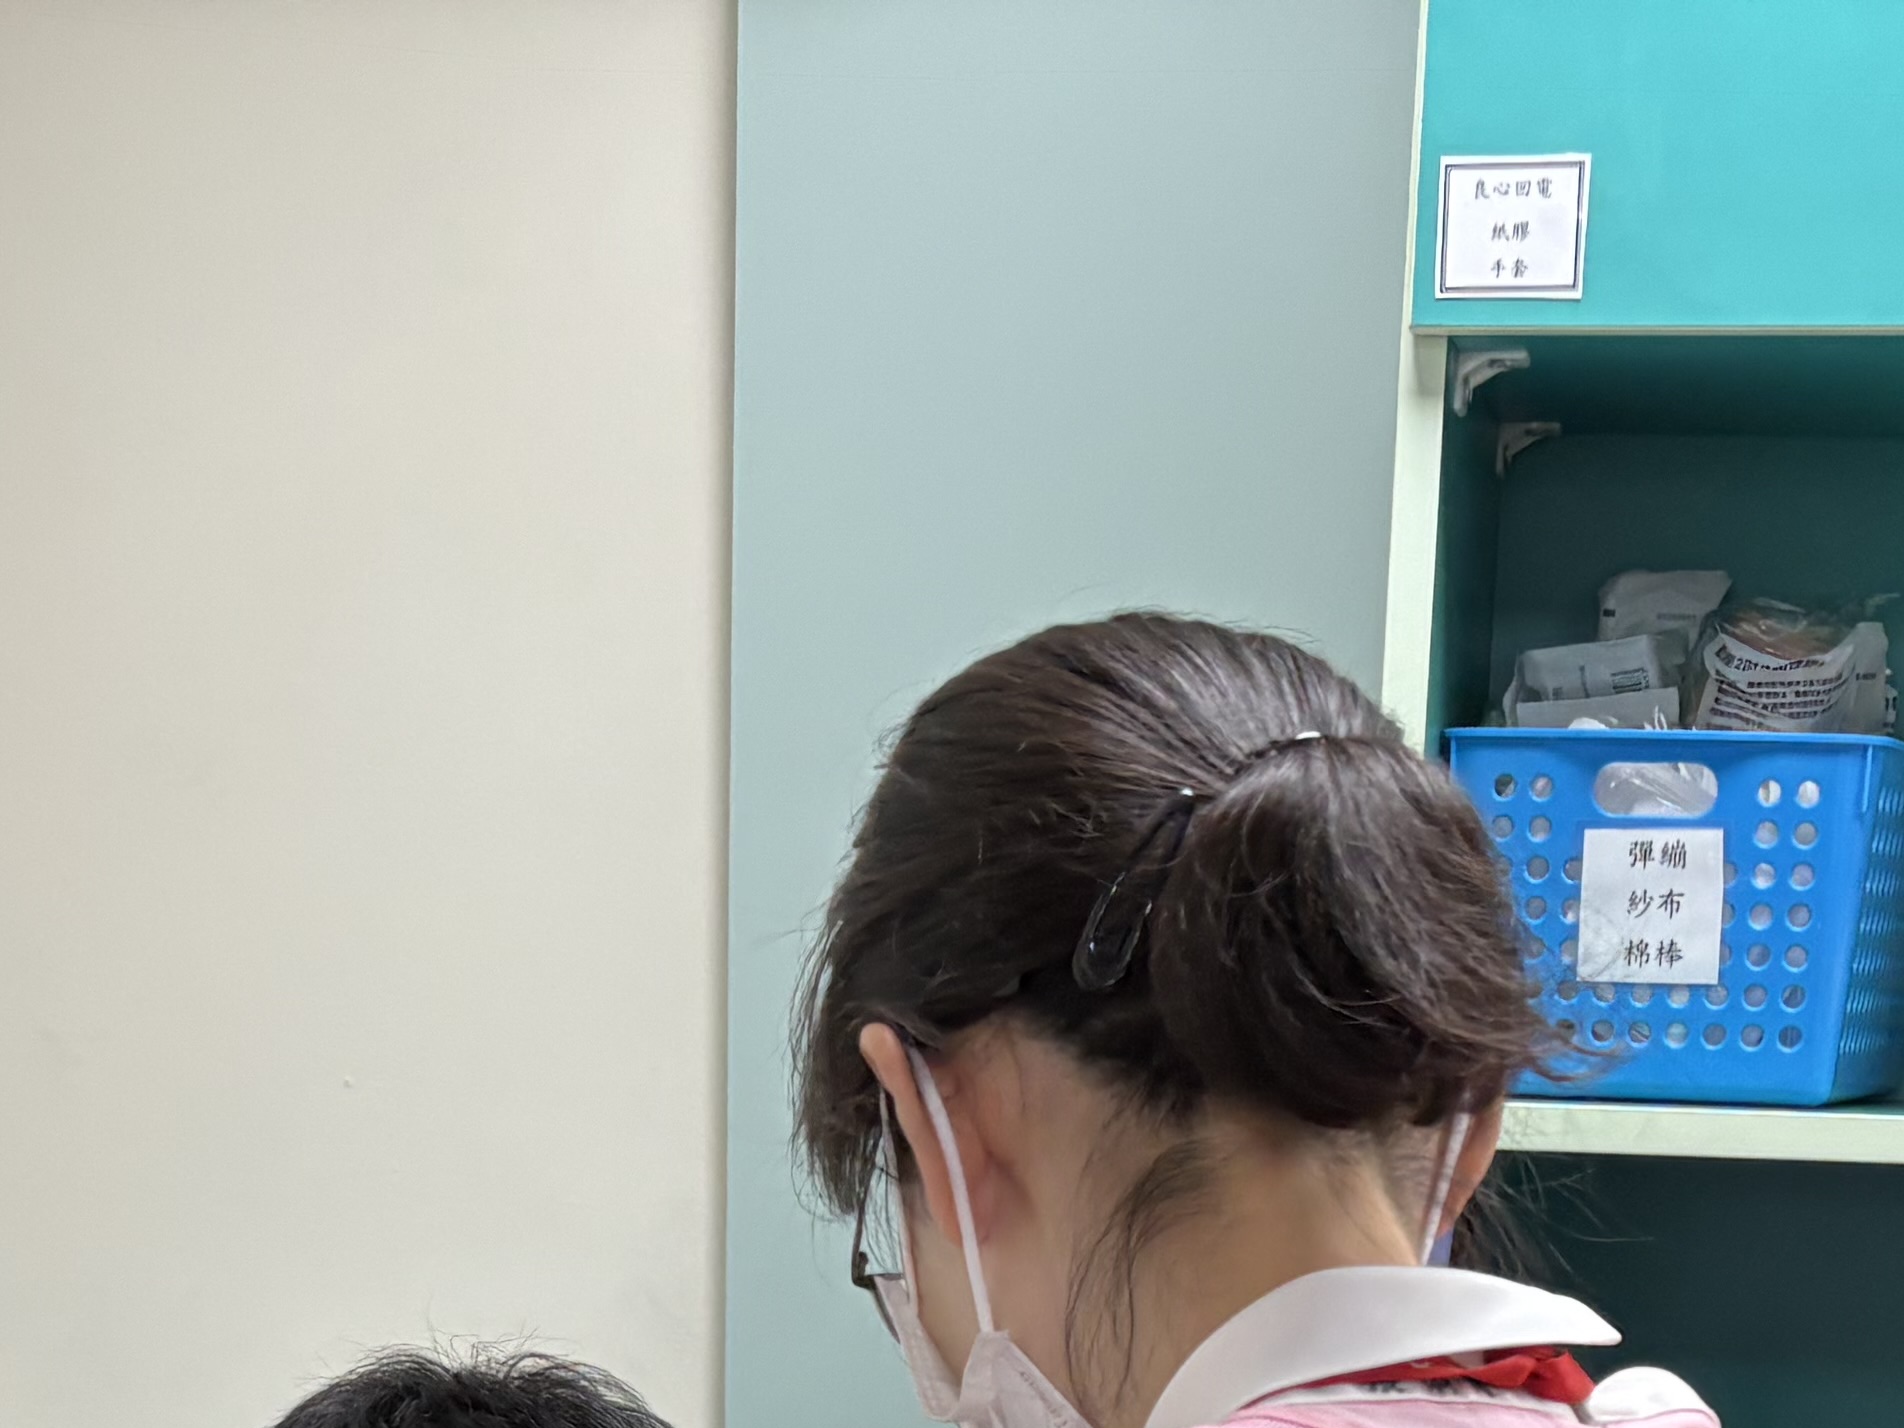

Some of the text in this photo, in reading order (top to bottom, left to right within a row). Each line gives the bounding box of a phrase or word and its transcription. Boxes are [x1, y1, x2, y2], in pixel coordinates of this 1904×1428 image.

[1628, 839, 1687, 869] 彈繃
[1626, 888, 1686, 919] 紗布
[1623, 938, 1685, 968] 棉棒
